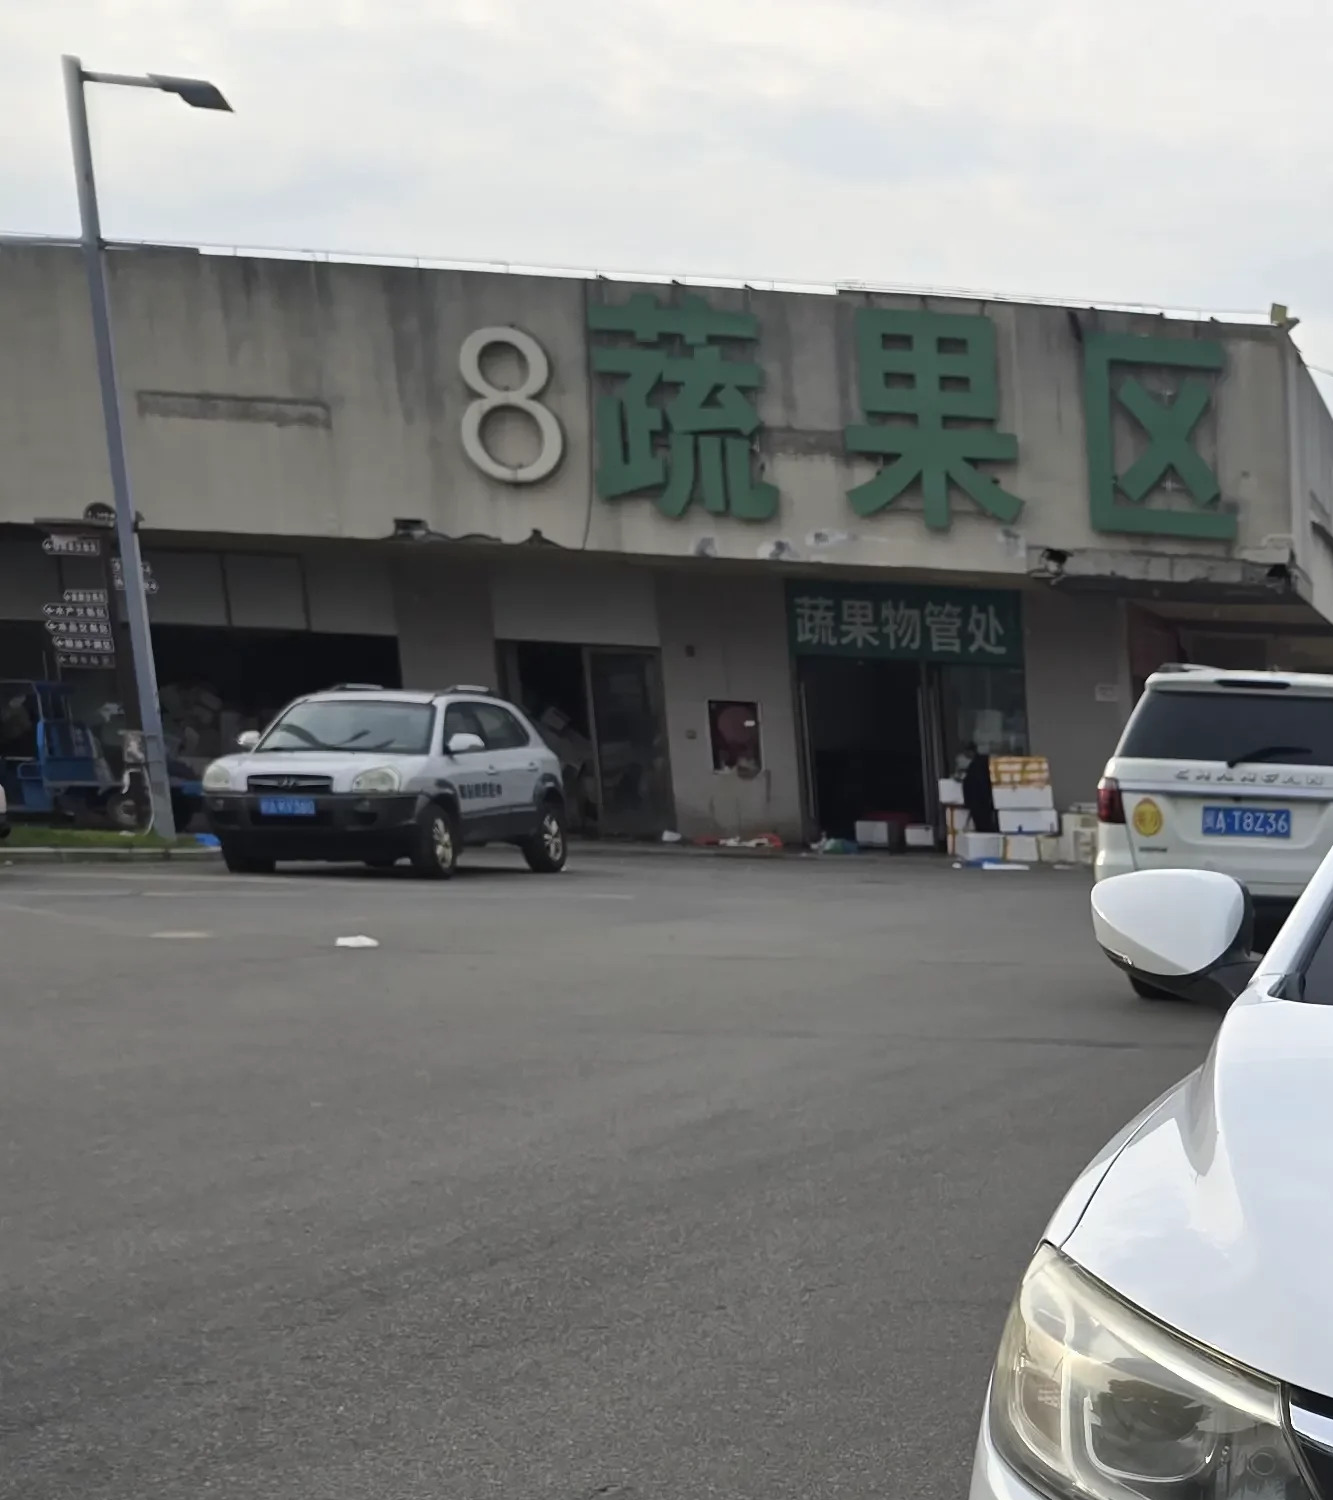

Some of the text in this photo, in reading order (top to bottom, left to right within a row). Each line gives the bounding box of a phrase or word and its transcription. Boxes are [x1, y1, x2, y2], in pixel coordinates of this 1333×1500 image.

[586, 292, 1238, 540] 蔬果区
[793, 596, 1007, 656] 蔬果物管处
